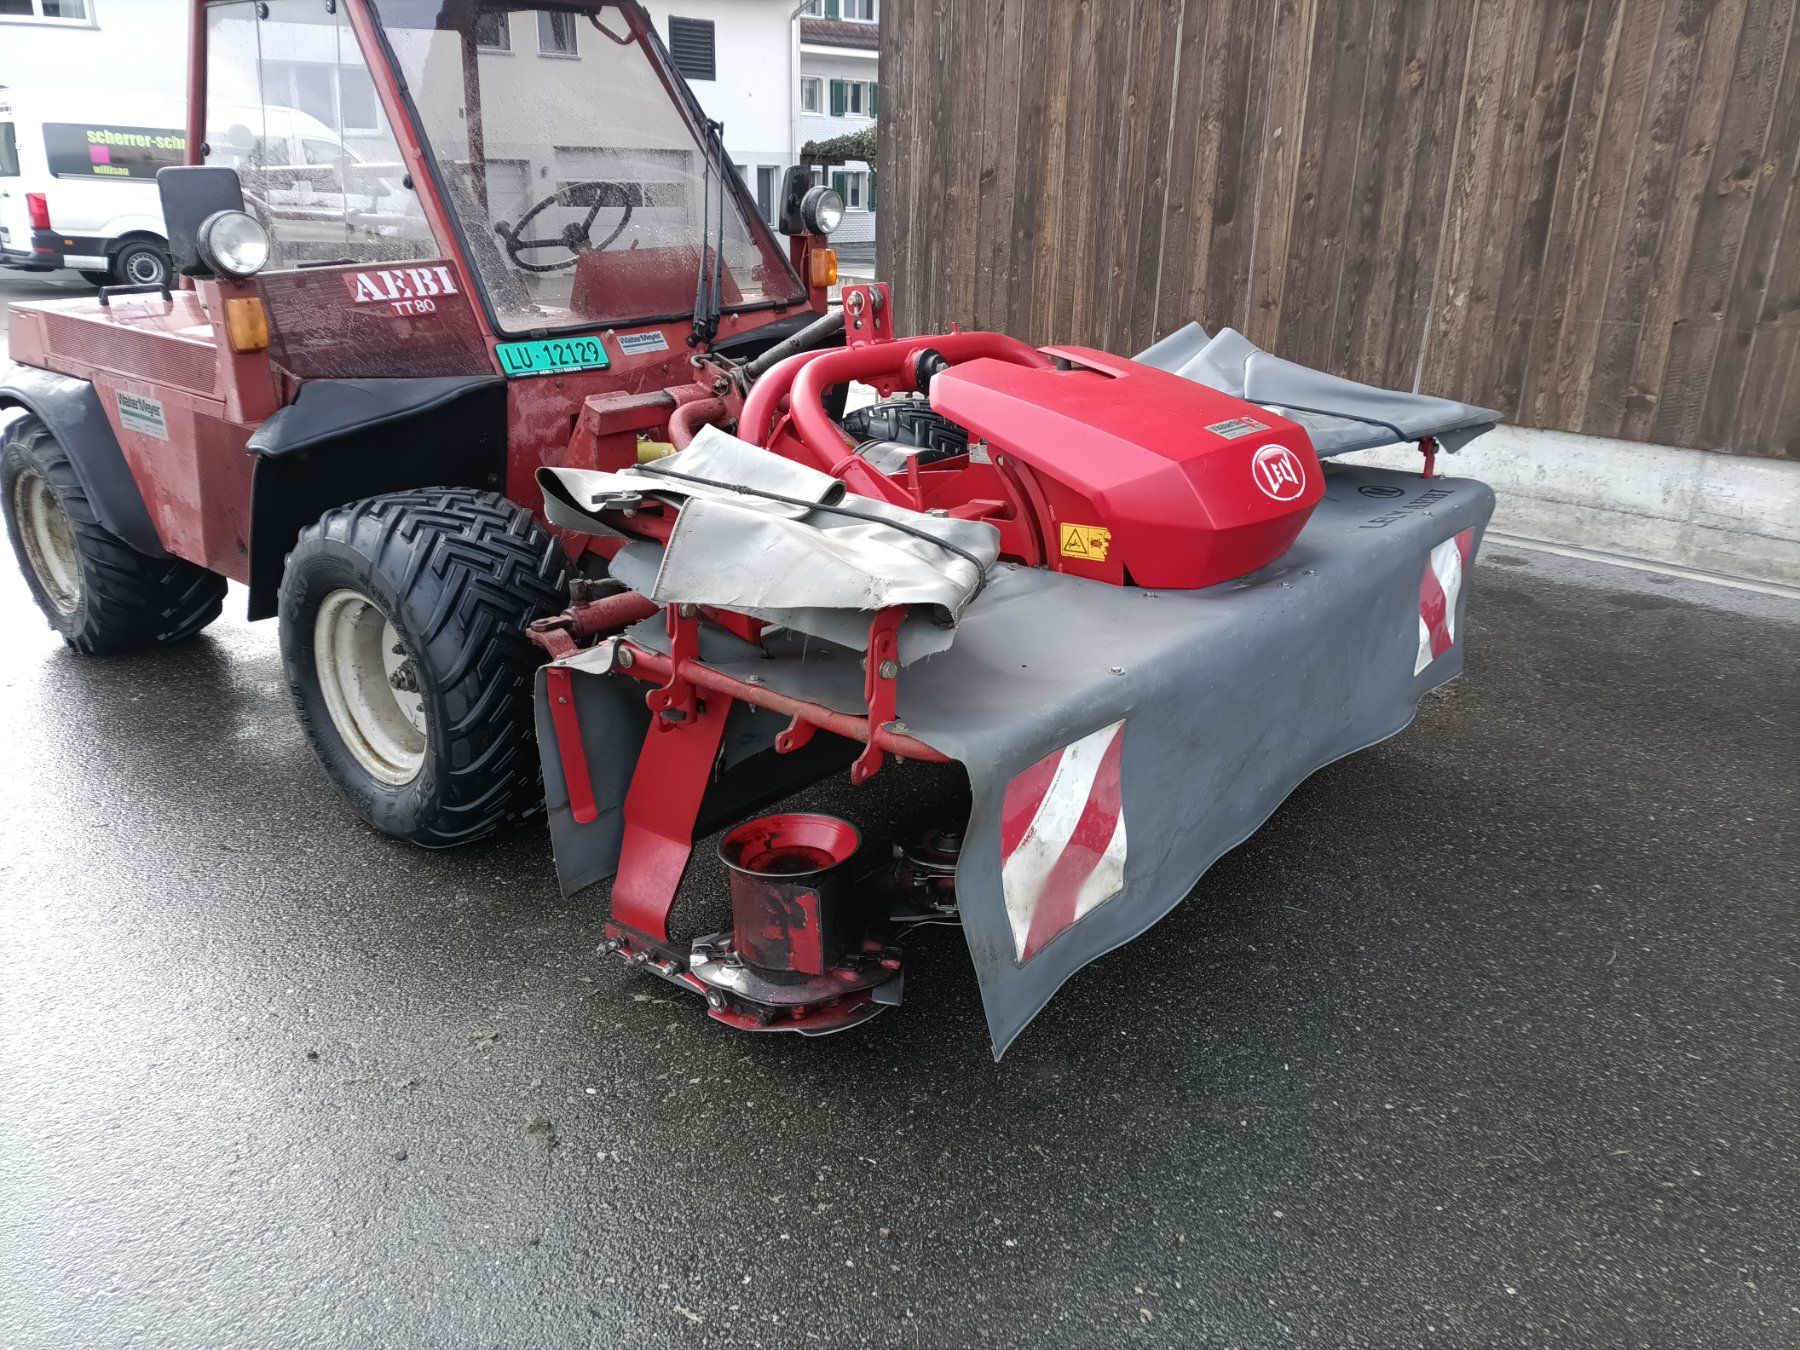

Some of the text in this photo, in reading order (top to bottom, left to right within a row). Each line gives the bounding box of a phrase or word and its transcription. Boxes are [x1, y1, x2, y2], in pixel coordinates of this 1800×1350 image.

[355, 266, 459, 302] AEBI
[391, 299, 435, 316] TT 80
[1258, 451, 1299, 494] LELY
